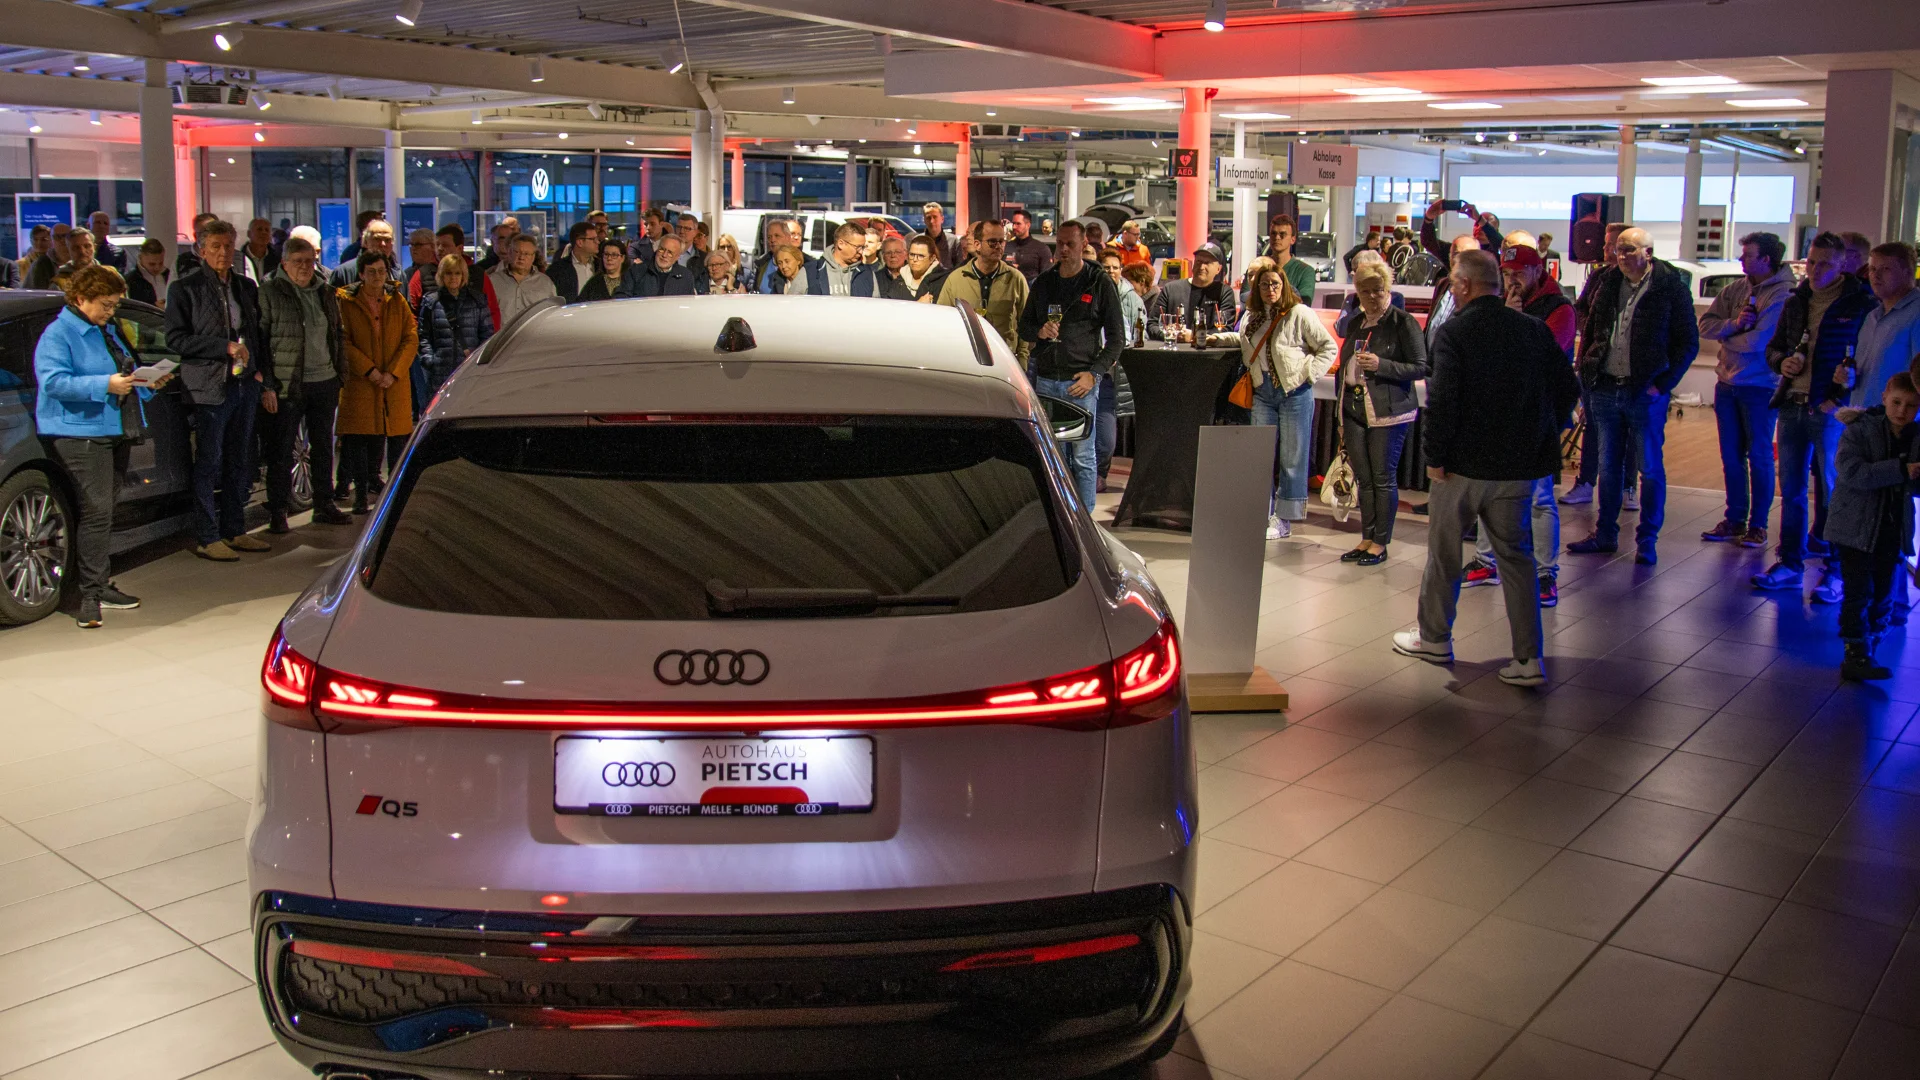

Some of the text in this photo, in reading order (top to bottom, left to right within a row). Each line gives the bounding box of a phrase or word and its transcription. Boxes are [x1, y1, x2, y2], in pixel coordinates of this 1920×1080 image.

[1313, 150, 1342, 166] Abholung
[1177, 168, 1193, 176] AED
[1224, 164, 1269, 180] Information
[1318, 168, 1336, 179] Kasse
[702, 744, 807, 759] AUTOHAUS
[701, 762, 808, 781] PIETSCH
[381, 799, 418, 818] Q5
[648, 804, 691, 815] PIETSCH
[701, 804, 732, 814] MELLE
[743, 803, 779, 814] BÜNDE
